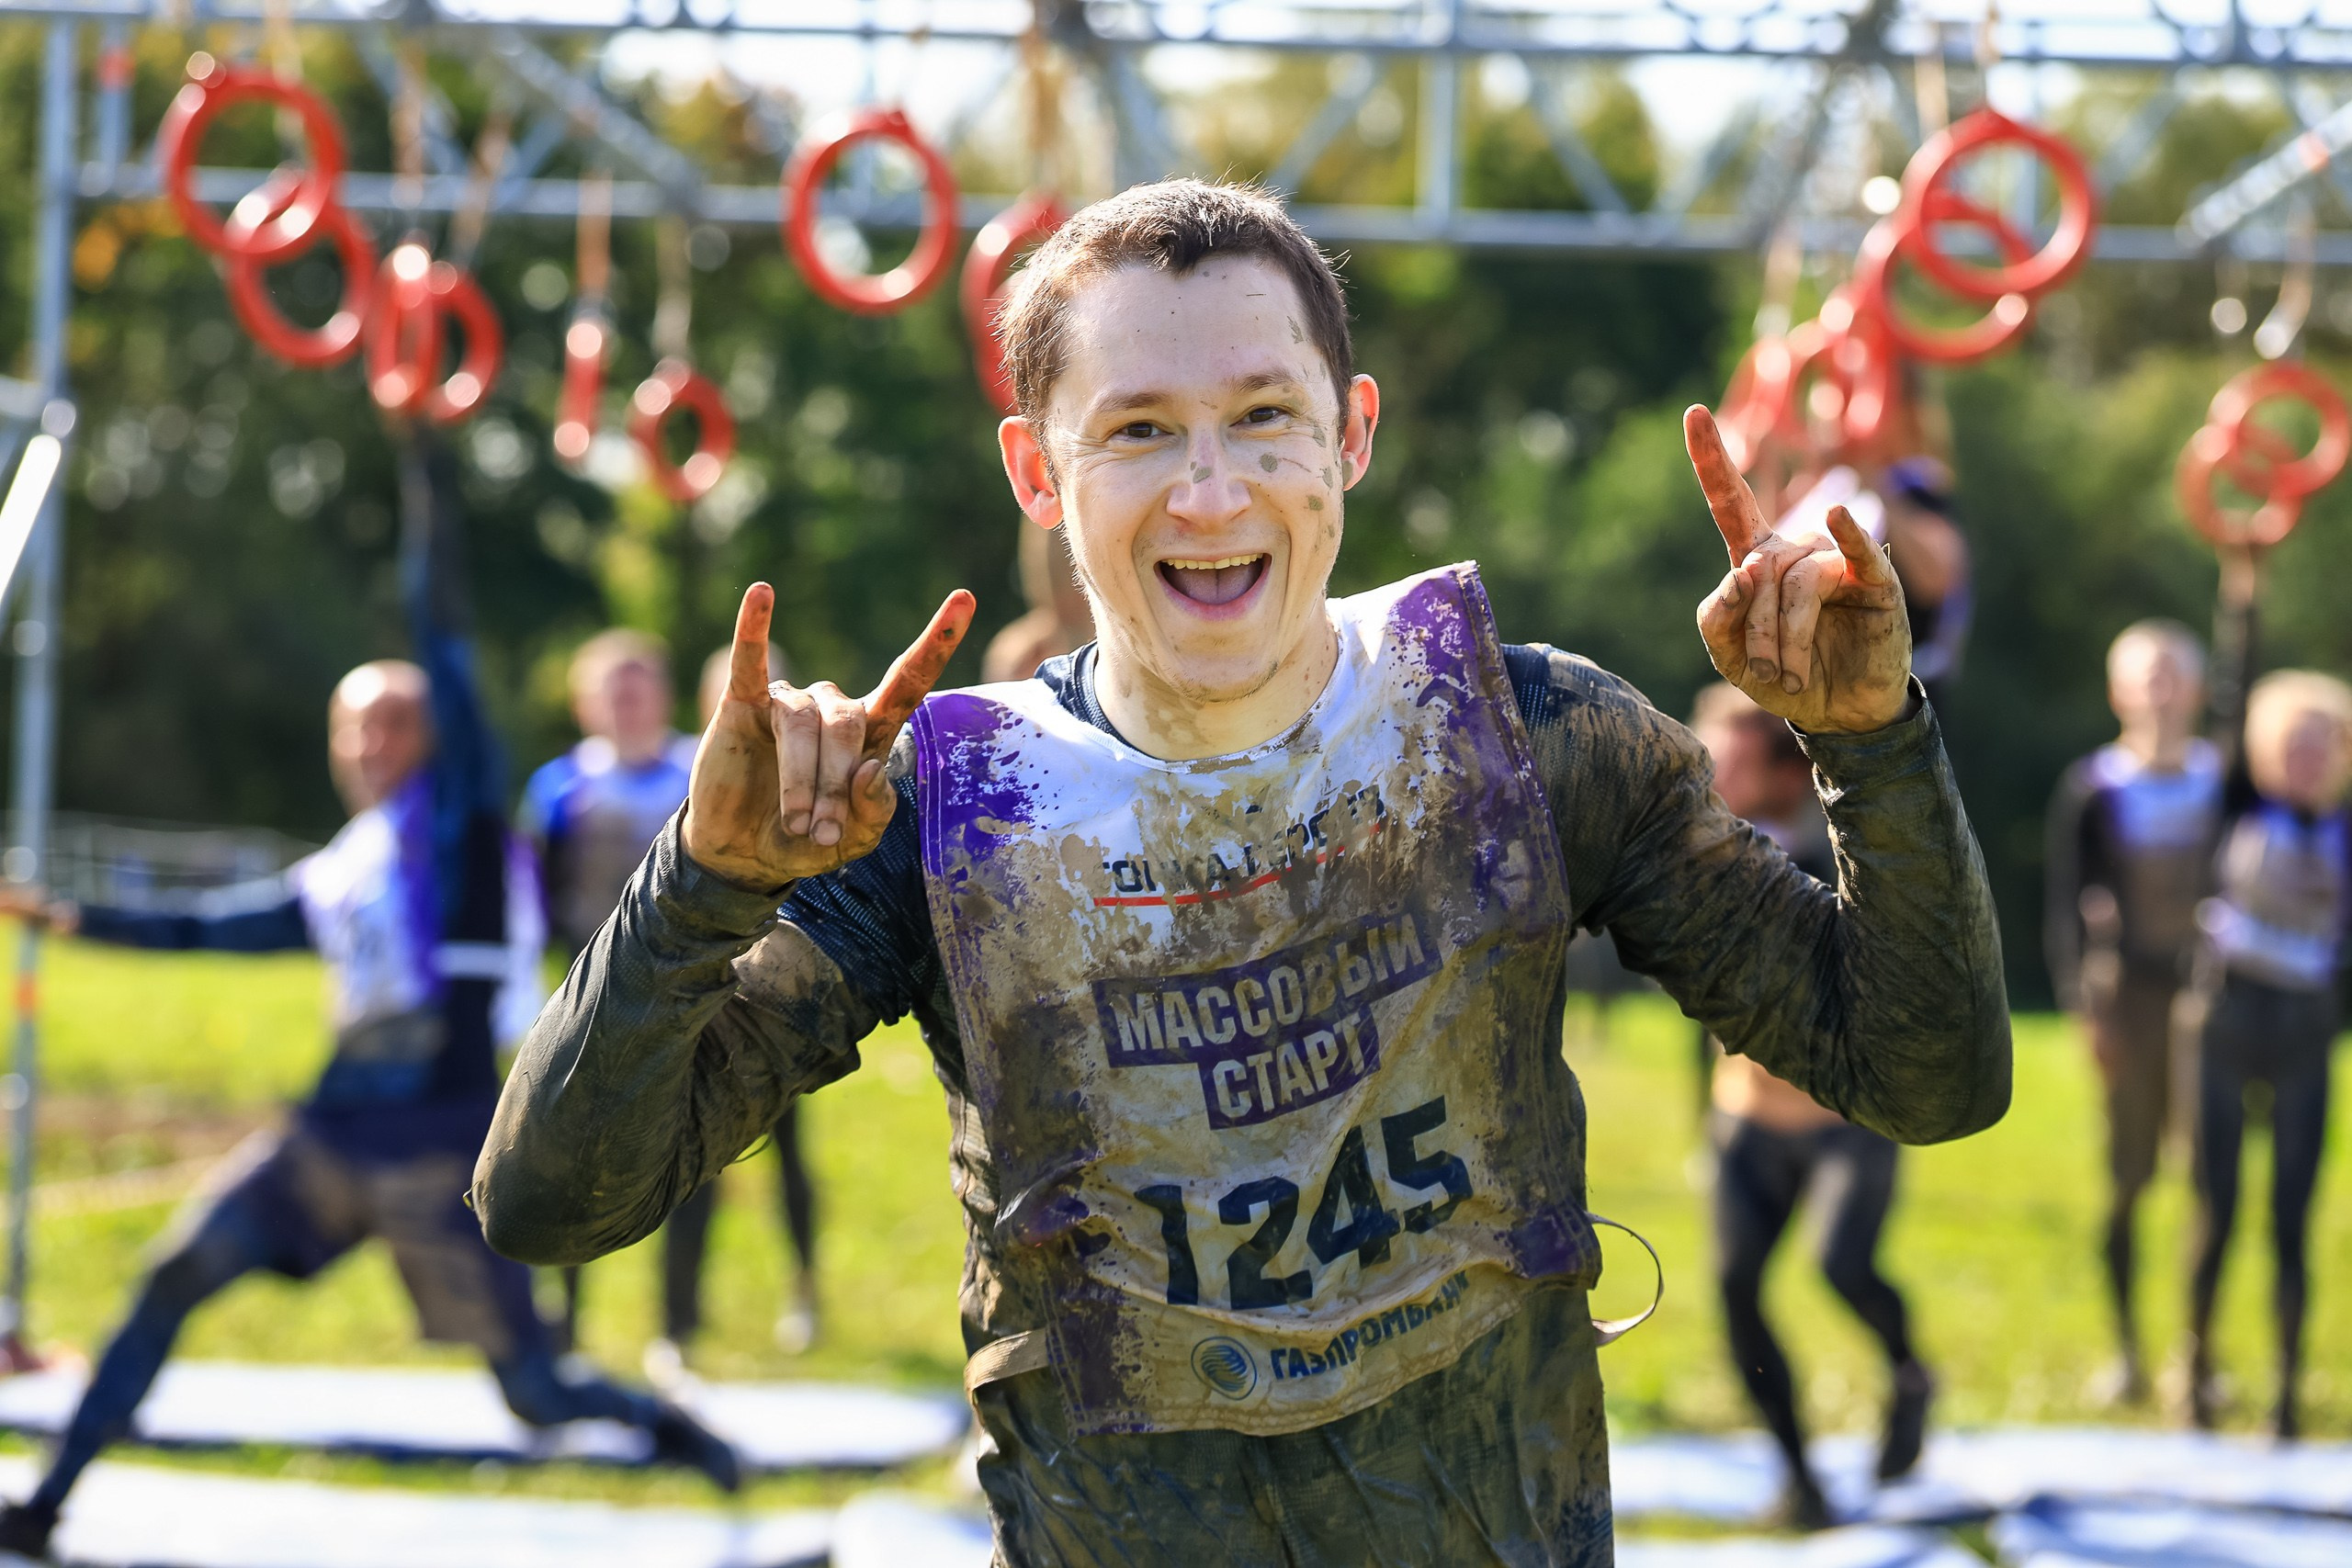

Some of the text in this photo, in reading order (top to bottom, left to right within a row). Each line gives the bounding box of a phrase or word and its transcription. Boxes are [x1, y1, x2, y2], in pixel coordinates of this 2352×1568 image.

[1109, 899, 1426, 1053] МАССОВЫЙ
[1212, 1012, 1366, 1119] СТАРТ
[1133, 1094, 1475, 1311] 1245
